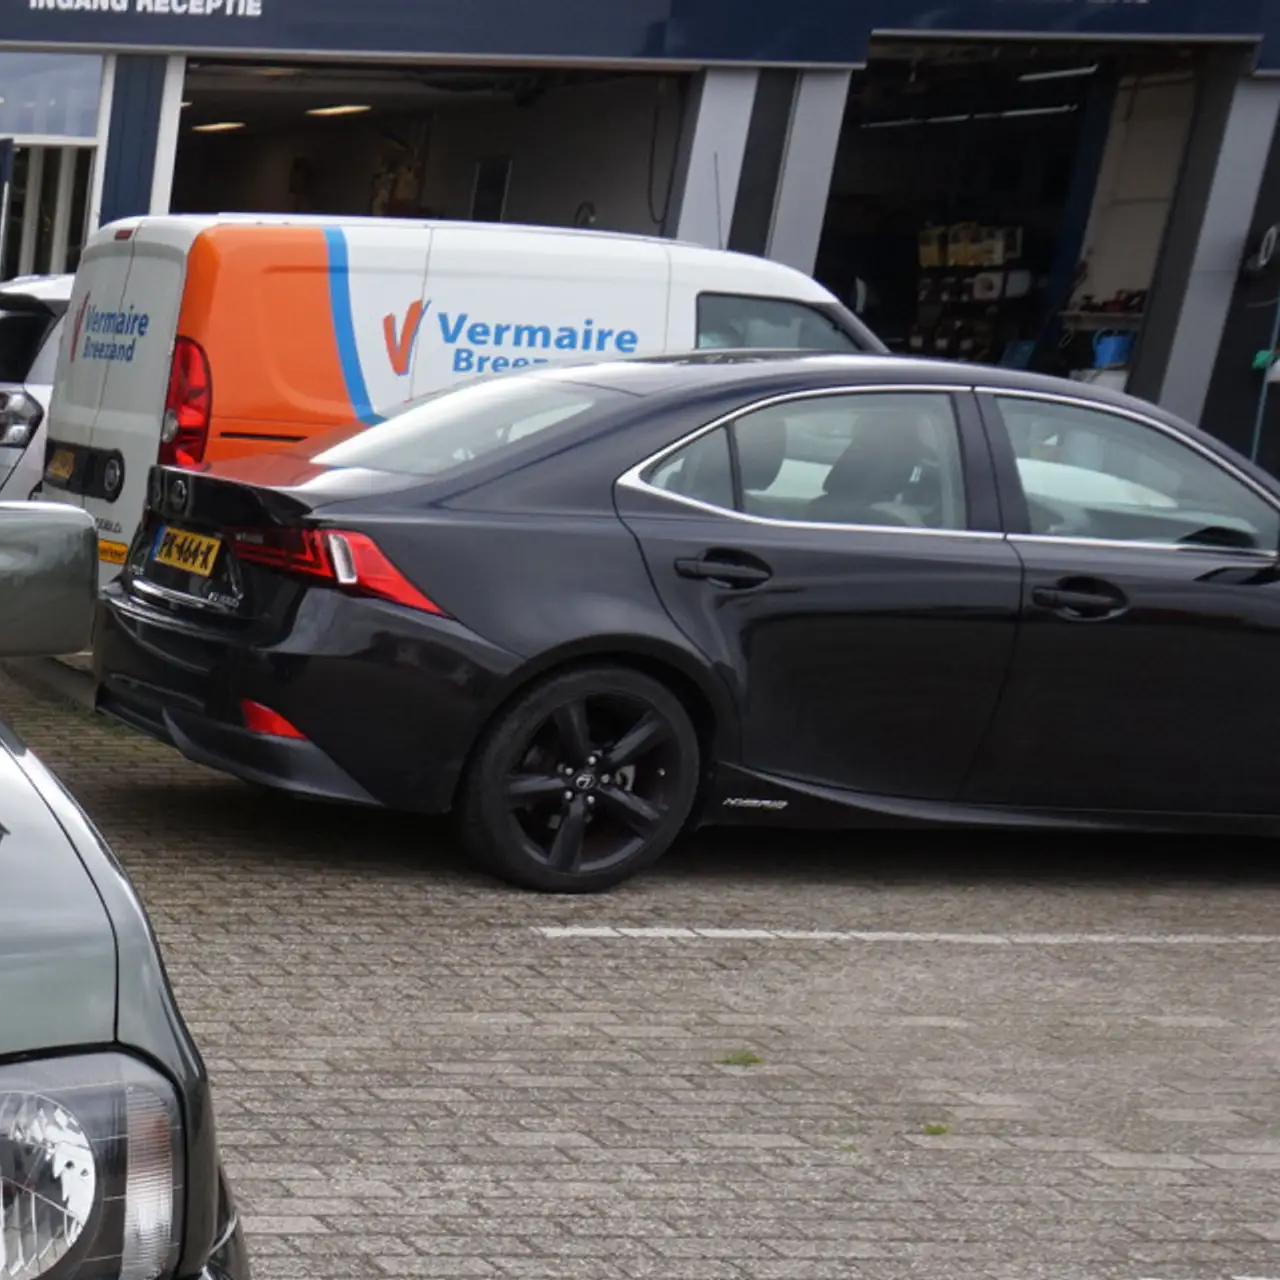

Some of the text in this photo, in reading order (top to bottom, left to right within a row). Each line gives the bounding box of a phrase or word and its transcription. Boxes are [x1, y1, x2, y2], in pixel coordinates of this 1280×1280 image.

[85, 303, 150, 336] Vermaire
[438, 312, 639, 353] Vermaire
[83, 336, 137, 362] Breezand
[453, 348, 549, 374] Bree
